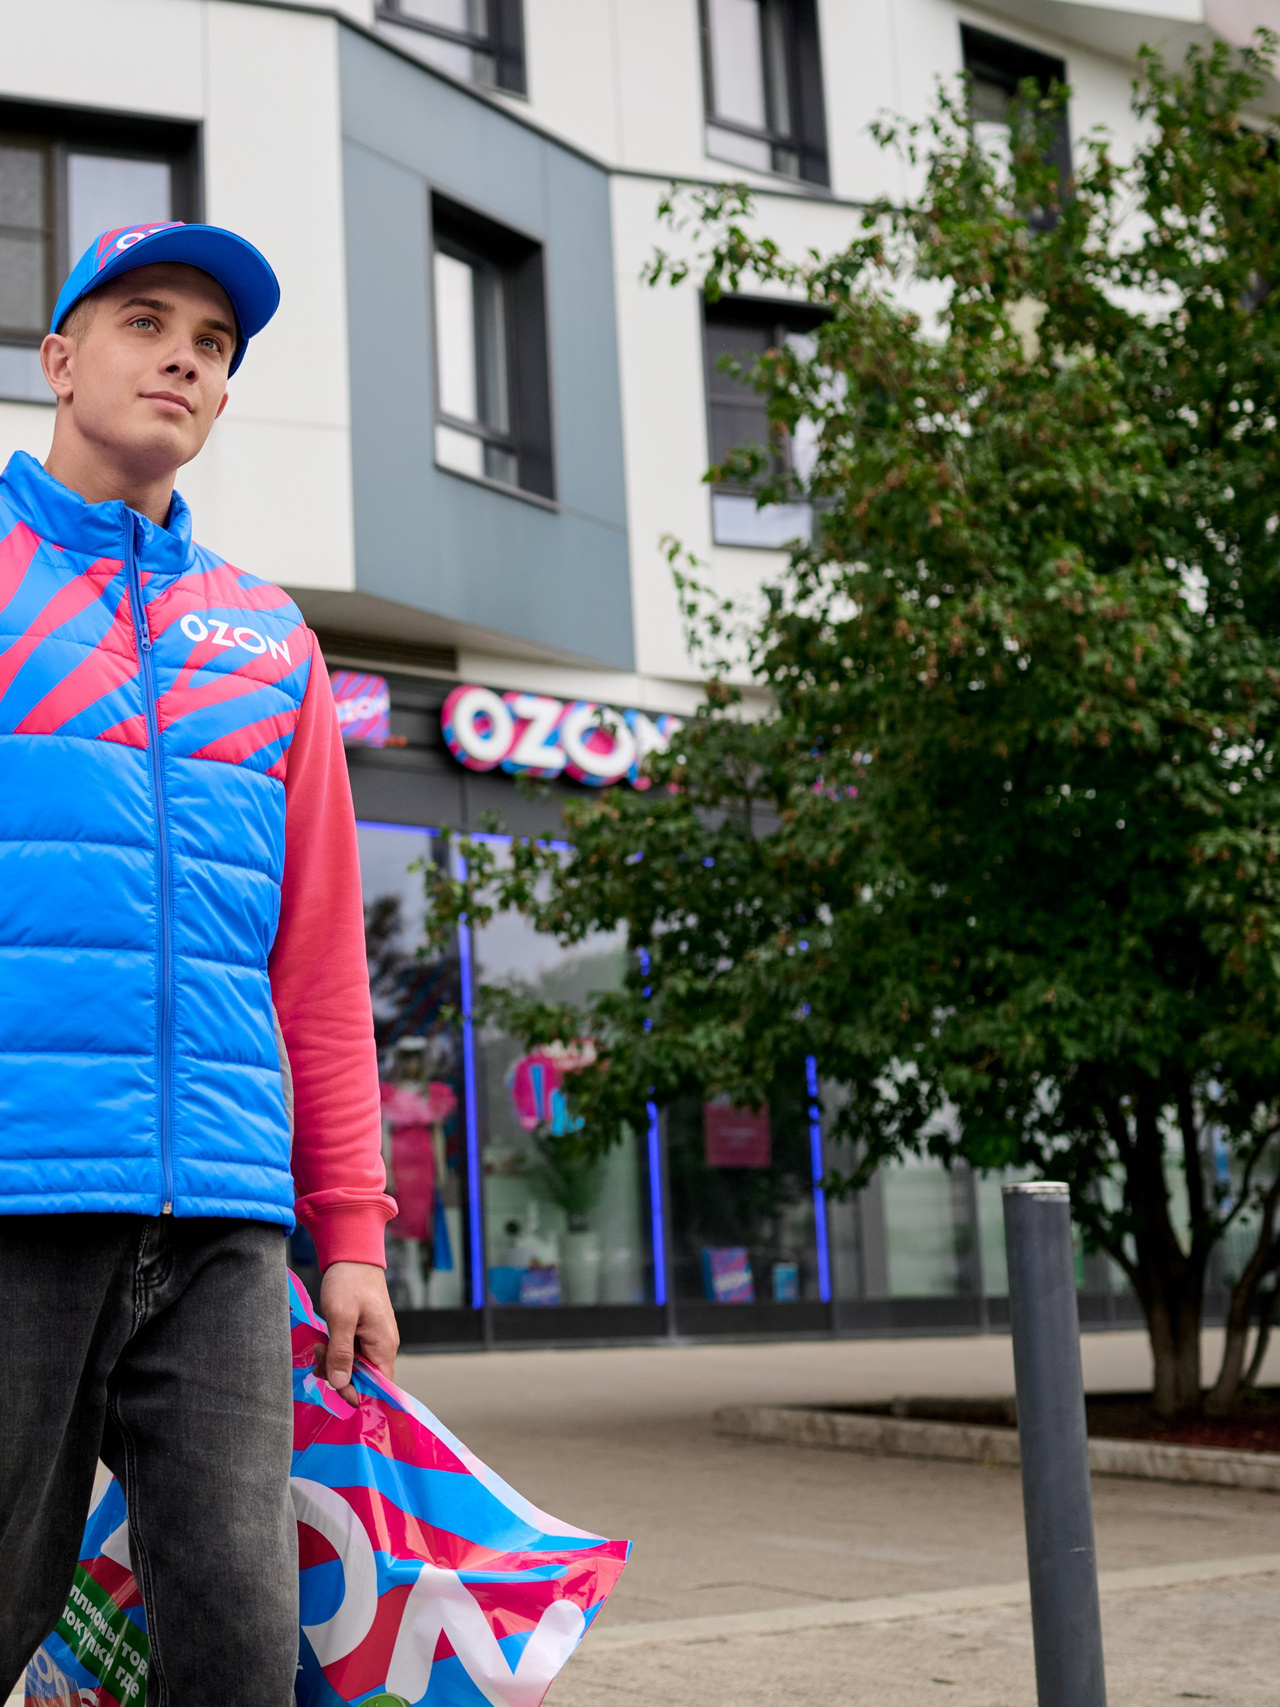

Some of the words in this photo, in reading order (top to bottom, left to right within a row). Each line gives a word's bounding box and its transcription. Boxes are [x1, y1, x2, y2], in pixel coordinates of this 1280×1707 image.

[180, 614, 292, 667] OZON
[121, 1642, 148, 1680] тов
[115, 1665, 140, 1699] где
